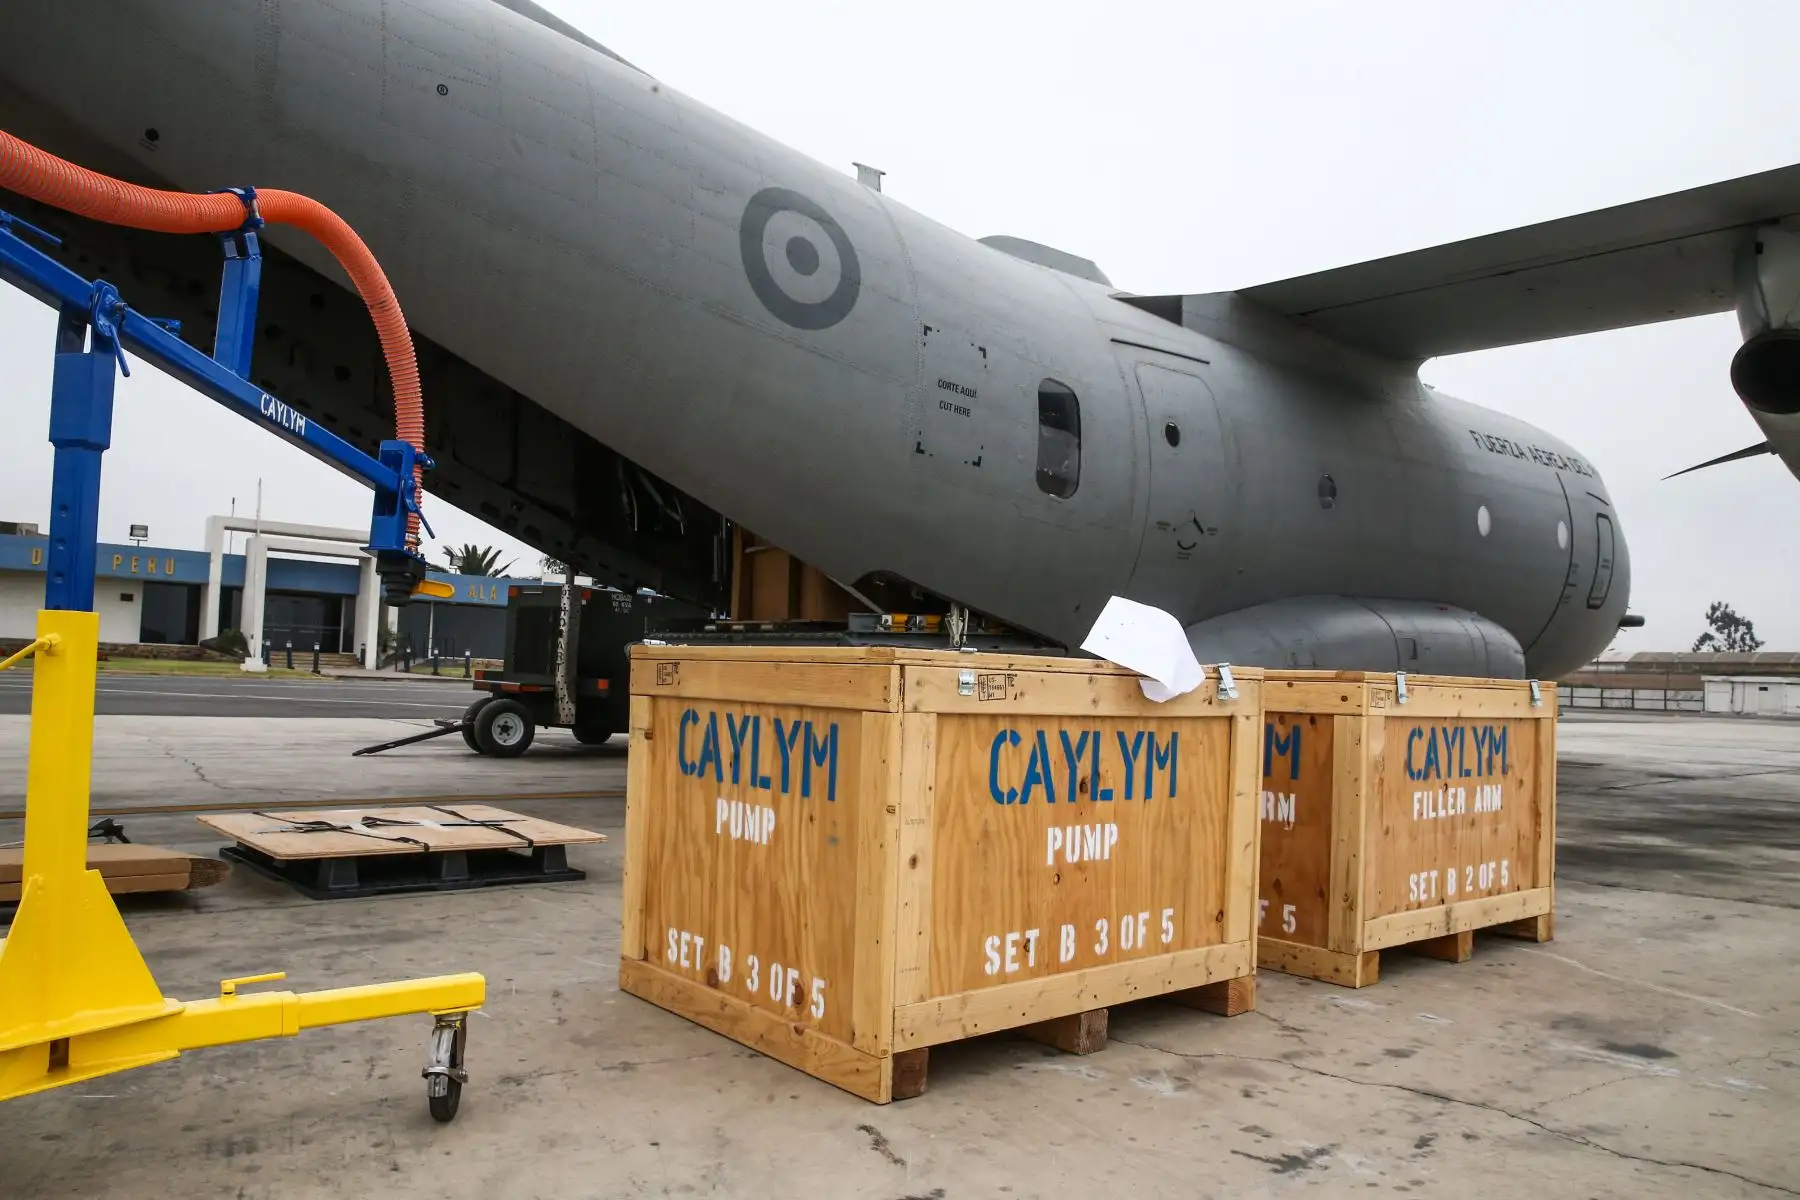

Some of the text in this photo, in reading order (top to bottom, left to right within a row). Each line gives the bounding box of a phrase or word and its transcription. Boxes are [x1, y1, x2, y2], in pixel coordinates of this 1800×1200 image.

[937, 379, 960, 393] CORTE
[261, 393, 306, 436] CAYLYM
[939, 400, 971, 417] CUT HERE
[1469, 429, 1529, 461] FUERZA
[113, 554, 175, 575] PERU
[468, 584, 497, 600] ALA
[679, 708, 838, 801] CAYLYM
[989, 729, 1179, 805] CAYLYM
[1407, 726, 1507, 781] CAYLYM
[716, 798, 776, 844] PUMP
[1261, 791, 1296, 823] RM
[1413, 784, 1502, 821] FILLER ARM
[1047, 823, 1118, 865] PUMP
[1409, 859, 1509, 902] SET B 2 OF 5
[1282, 904, 1296, 934] 5
[984, 908, 1174, 975] SET B 3 OF 5
[667, 927, 825, 1019] SET B 3 OF 5
